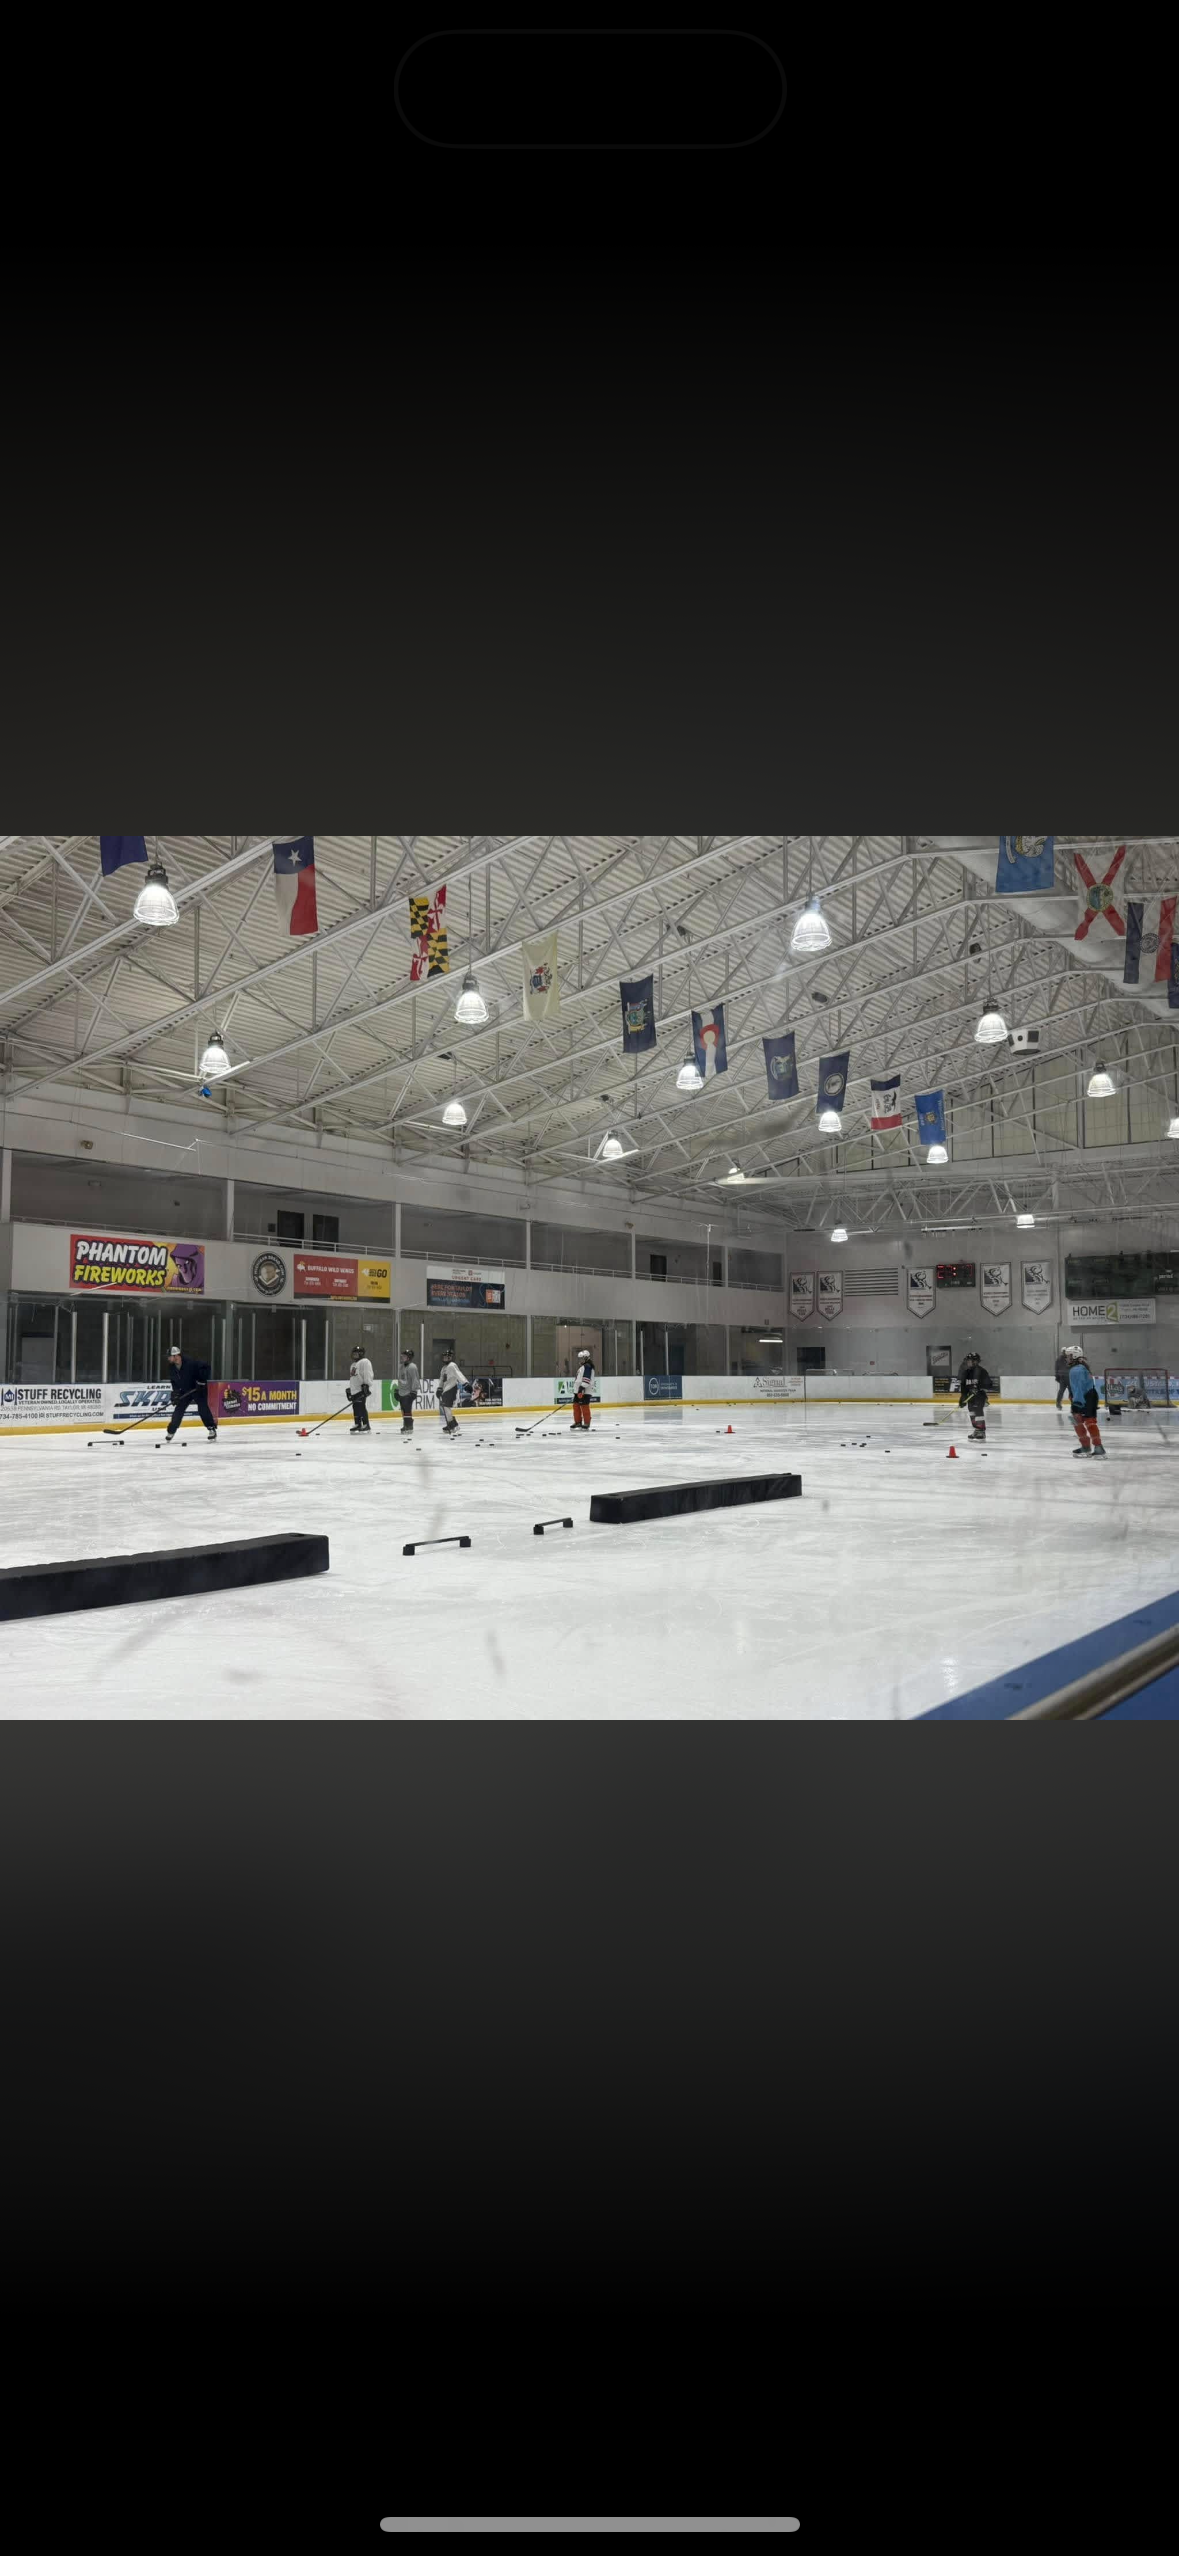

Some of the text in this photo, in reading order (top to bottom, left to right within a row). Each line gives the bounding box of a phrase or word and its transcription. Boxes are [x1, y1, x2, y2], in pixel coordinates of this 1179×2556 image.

[76, 1240, 167, 1266] PHANTOM
[74, 1264, 165, 1286] FIREWORKS
[376, 1269, 388, 1278] GO
[418, 1379, 435, 1394] ADE
[762, 1376, 785, 1387] Signal
[18, 1388, 48, 1400] STUFF
[50, 1388, 102, 1400] RECYCLING
[114, 1391, 173, 1407] SKA
[242, 1386, 297, 1402] $15 A MONTH
[248, 1402, 297, 1412] NO COMMITMENT
[415, 1395, 435, 1410] RIM
